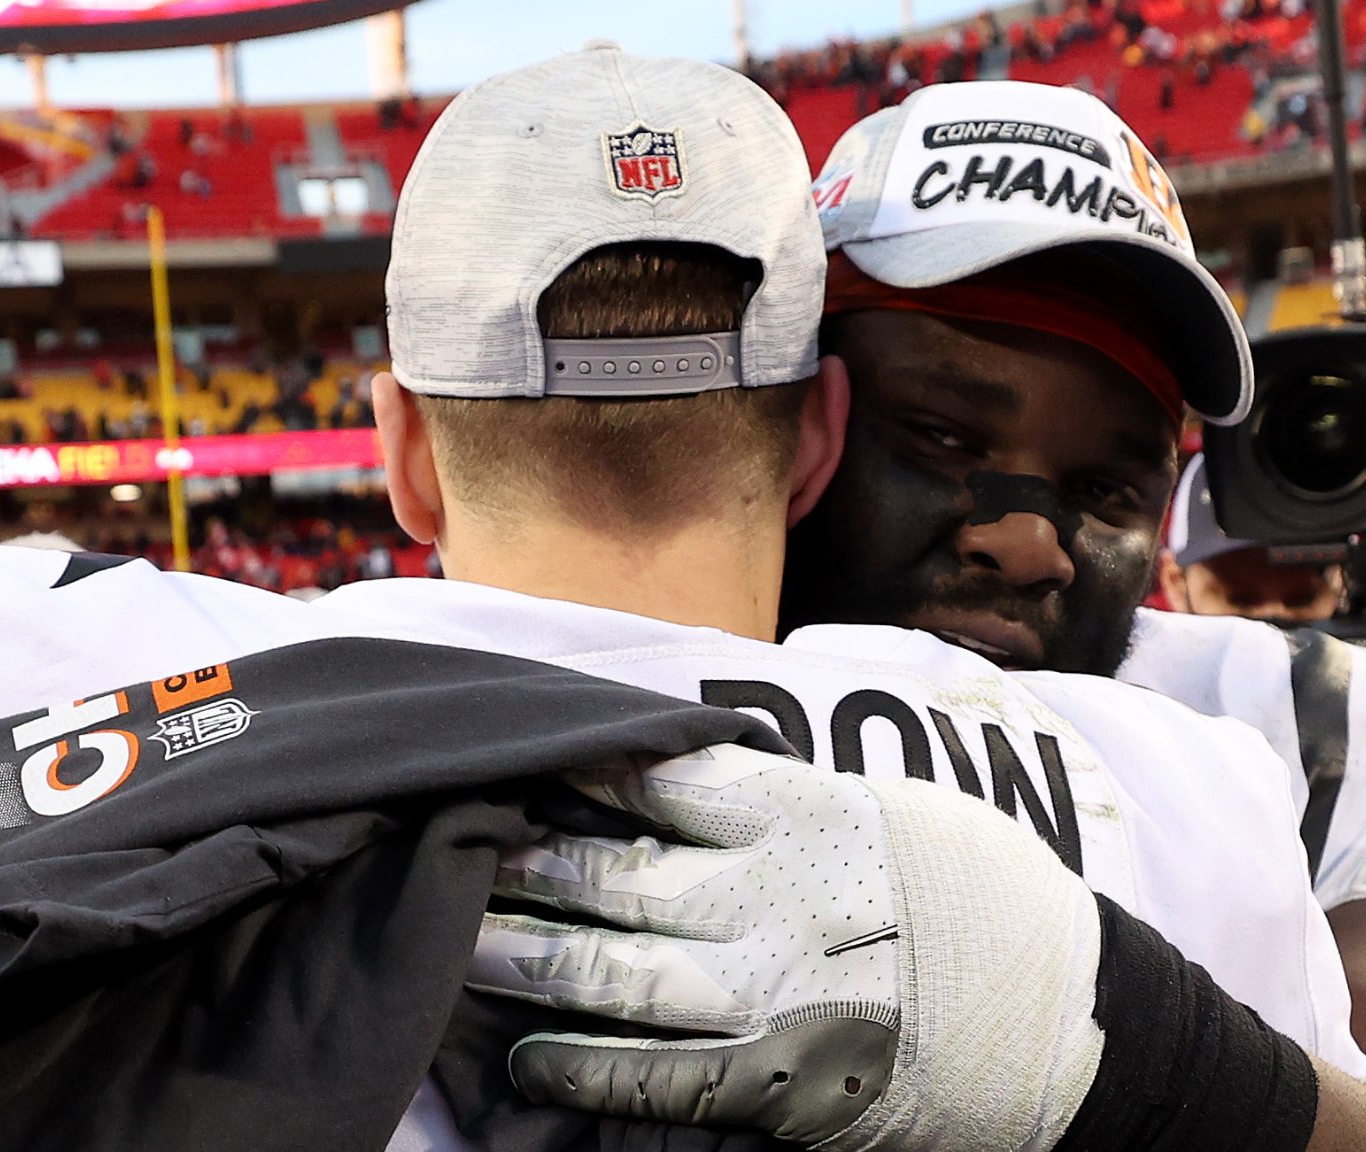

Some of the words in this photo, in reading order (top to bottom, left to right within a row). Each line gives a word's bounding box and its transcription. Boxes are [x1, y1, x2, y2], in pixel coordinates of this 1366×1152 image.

[932, 121, 1098, 154] CONFERENCE
[617, 155, 679, 191] NFL
[912, 155, 1176, 247] CHAMPIO
